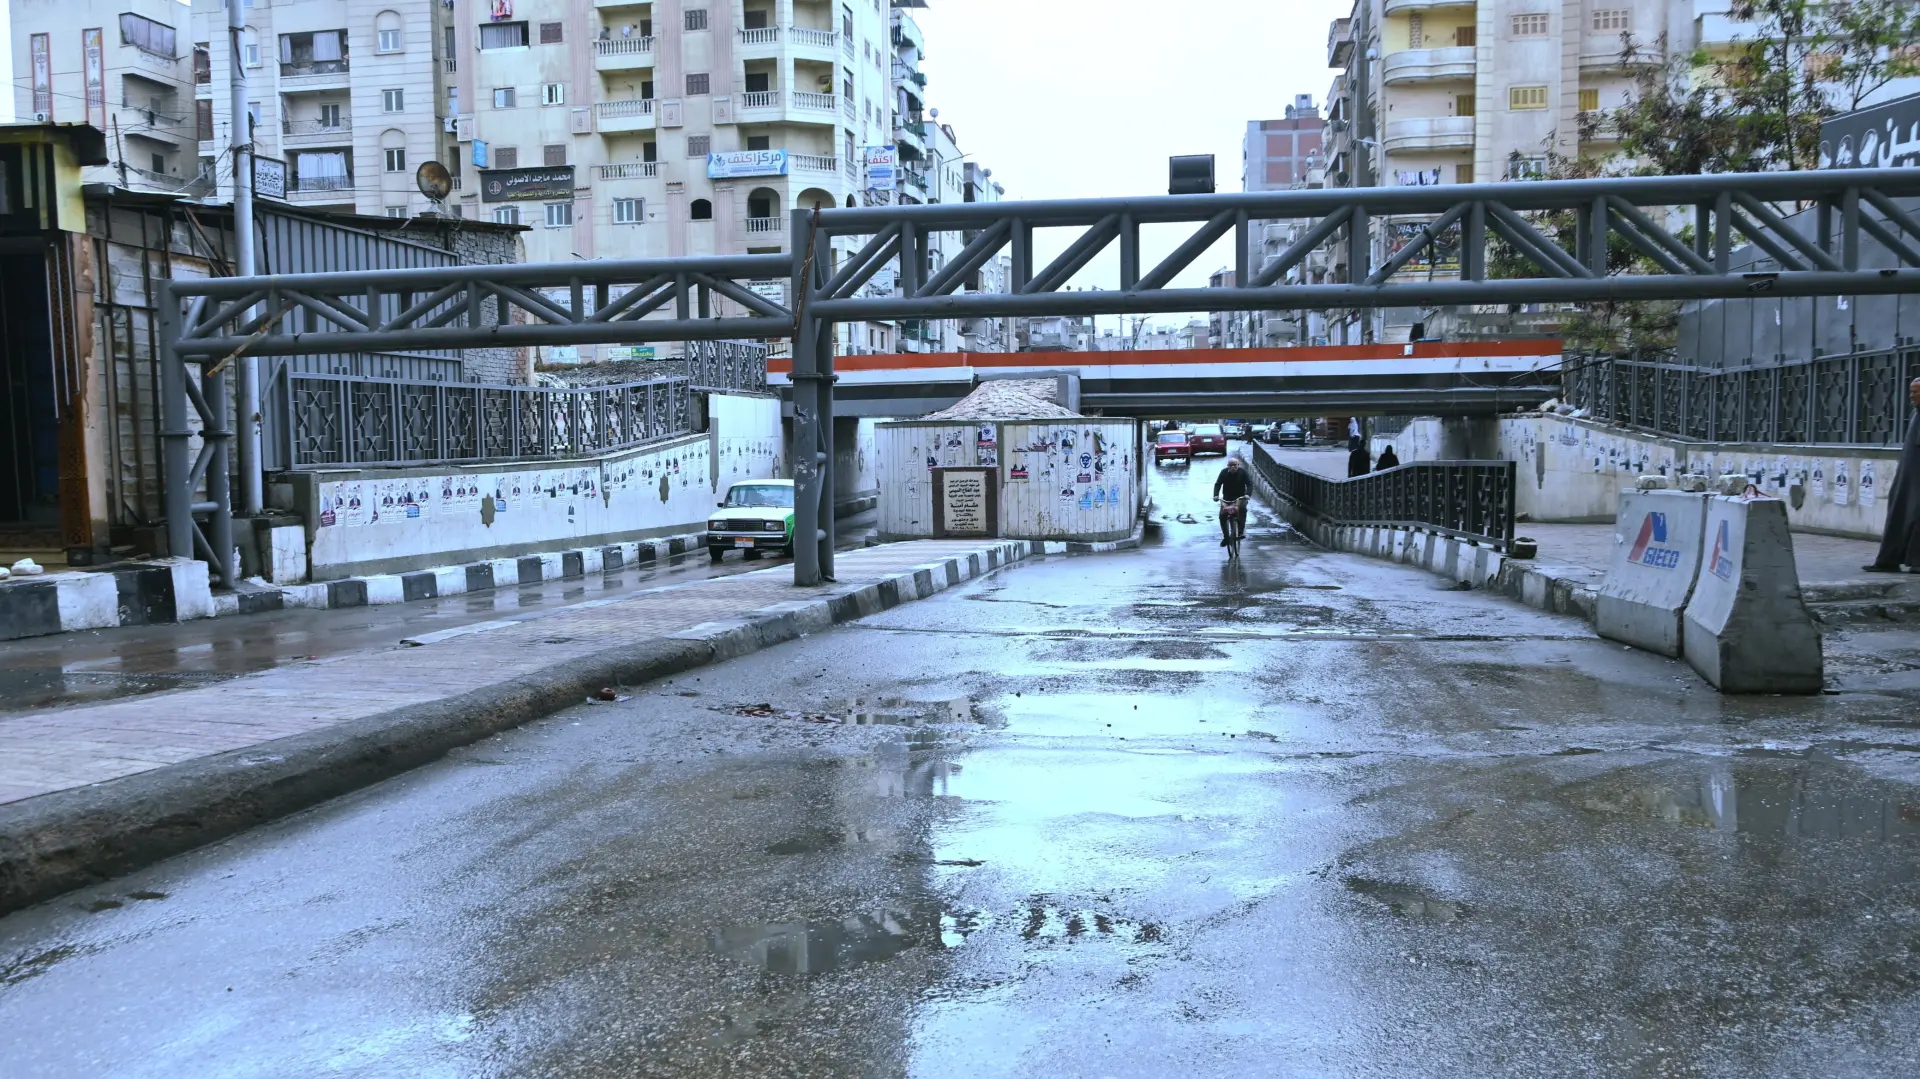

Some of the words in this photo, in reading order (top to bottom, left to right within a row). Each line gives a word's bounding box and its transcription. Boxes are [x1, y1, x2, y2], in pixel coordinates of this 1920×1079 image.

[755, 151, 782, 166] مركز
[532, 174, 551, 184] ماجد
[552, 173, 571, 182] محمد
